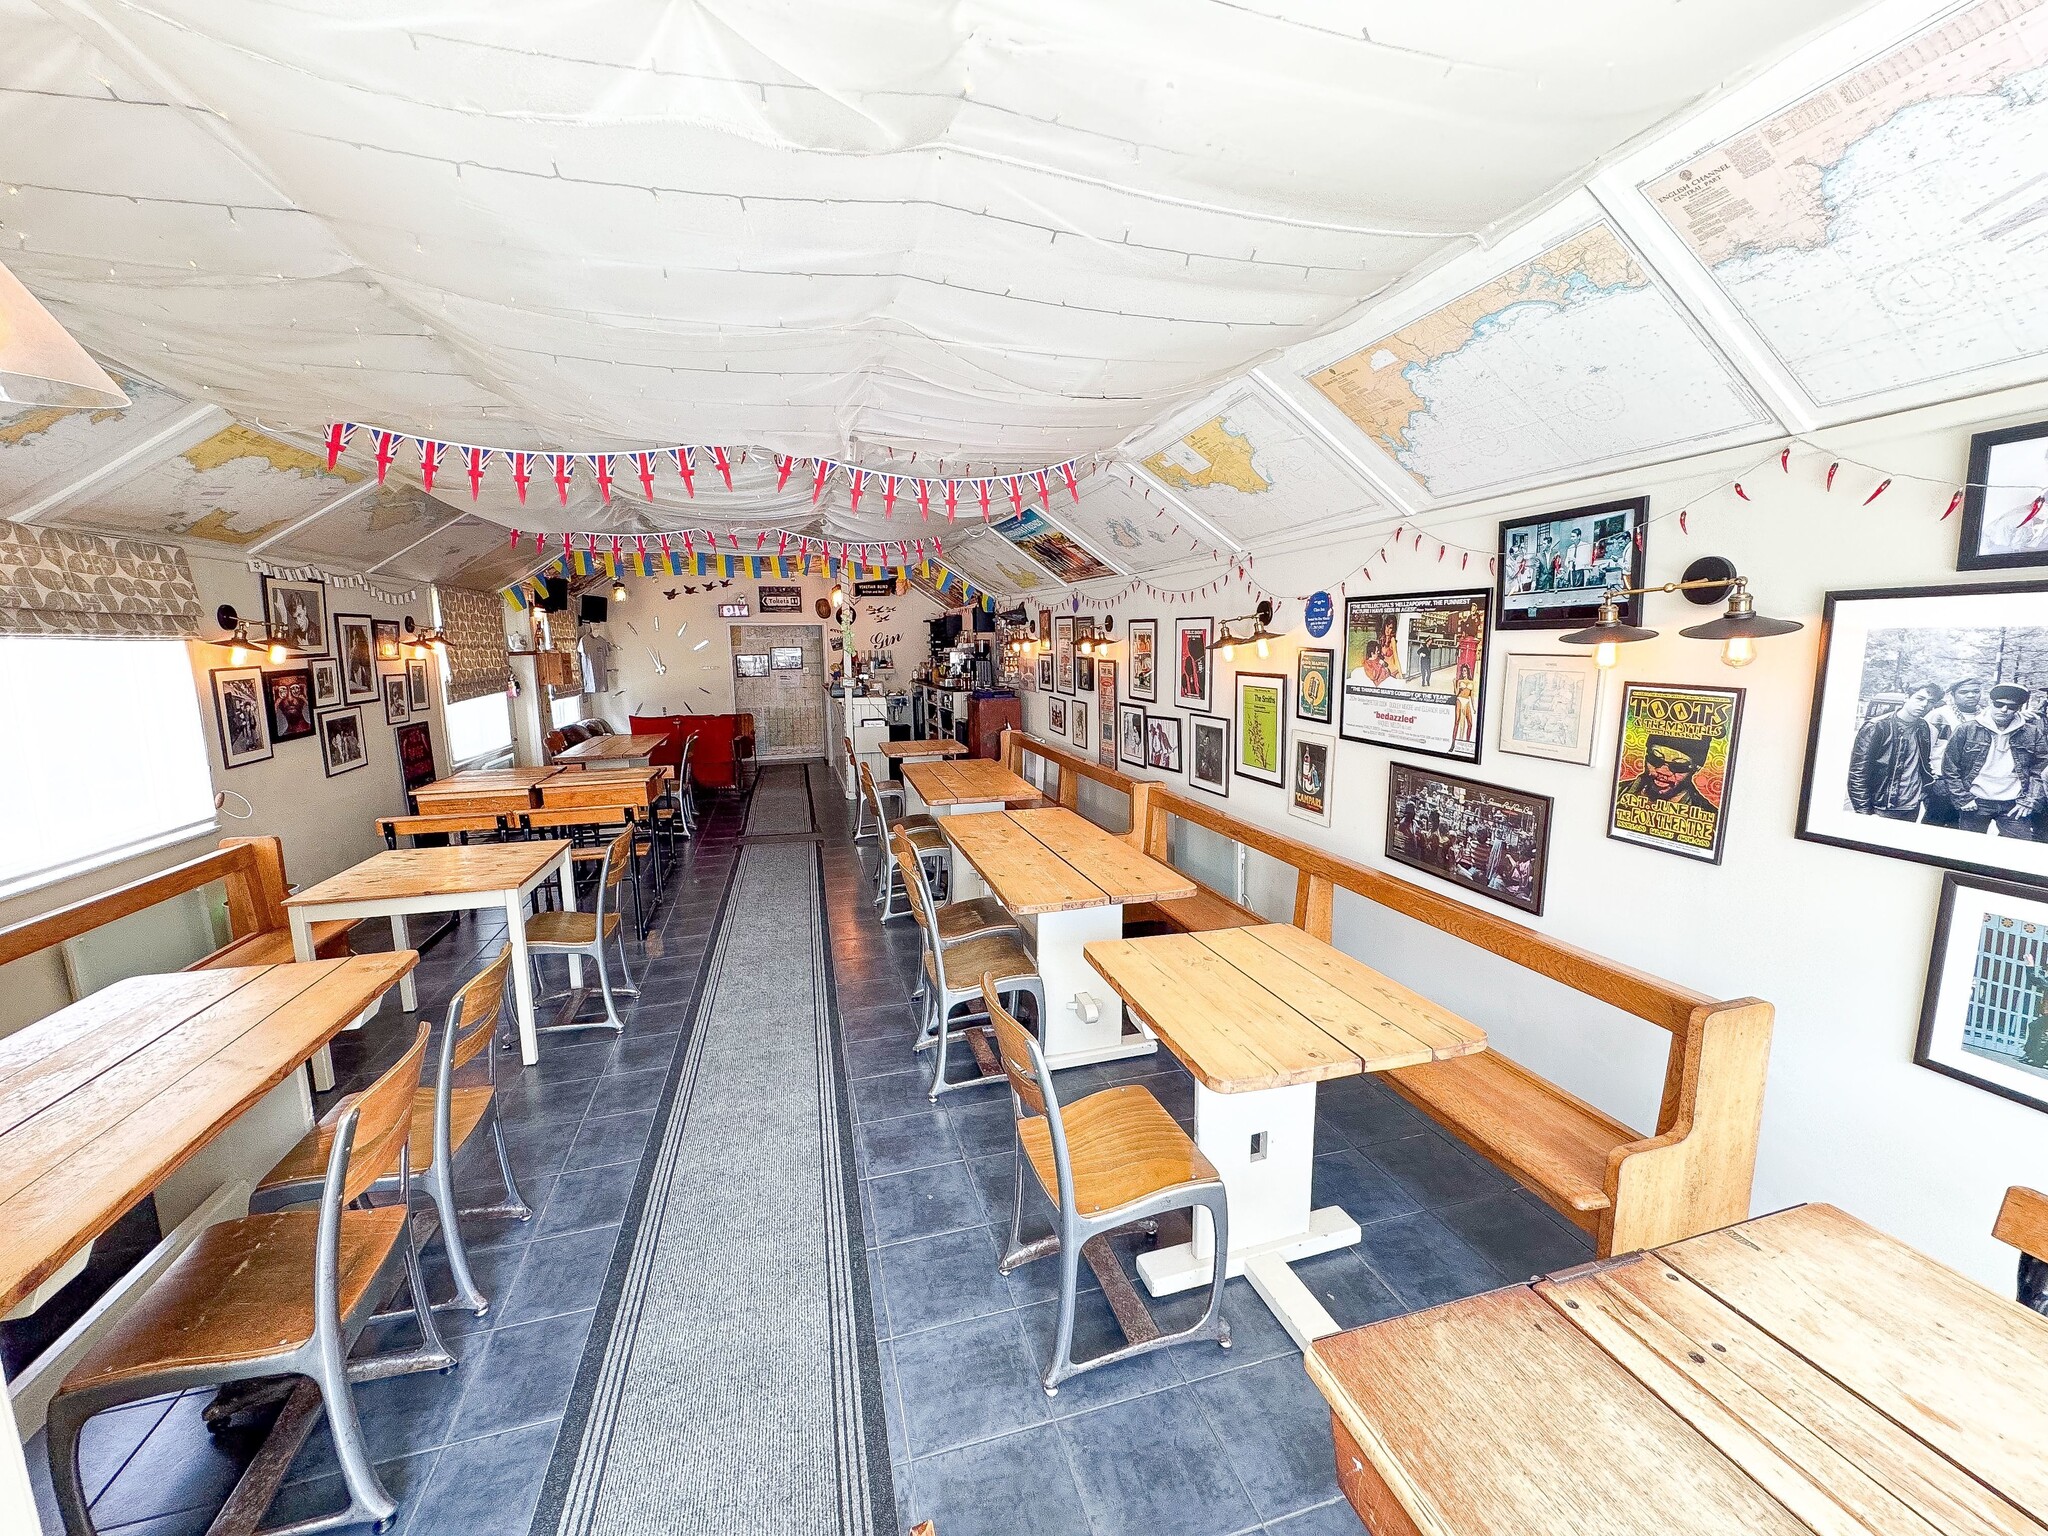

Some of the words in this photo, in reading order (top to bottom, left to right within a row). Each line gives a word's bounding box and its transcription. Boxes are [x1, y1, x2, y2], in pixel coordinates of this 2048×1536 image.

[1658, 183, 1690, 203] ENGLISH
[1691, 163, 1731, 186] CHANNEL
[1673, 185, 1702, 202] CENTRAL
[1704, 174, 1722, 187] PART
[1443, 598, 1471, 606] FUNNIEST
[870, 631, 904, 649] Gin
[1262, 694, 1276, 704] Smiths
[1631, 697, 1731, 726] TOOTS
[1633, 718, 1642, 728] &
[1645, 719, 1666, 731] THE
[1666, 720, 1723, 737] MAYTALS
[1620, 793, 1651, 810] SAT.
[1652, 799, 1689, 818] JUNE
[1690, 805, 1716, 822] 11TH
[1617, 808, 1631, 822] THE
[1630, 807, 1656, 828] FOX
[1656, 813, 1713, 840] THEATRE
